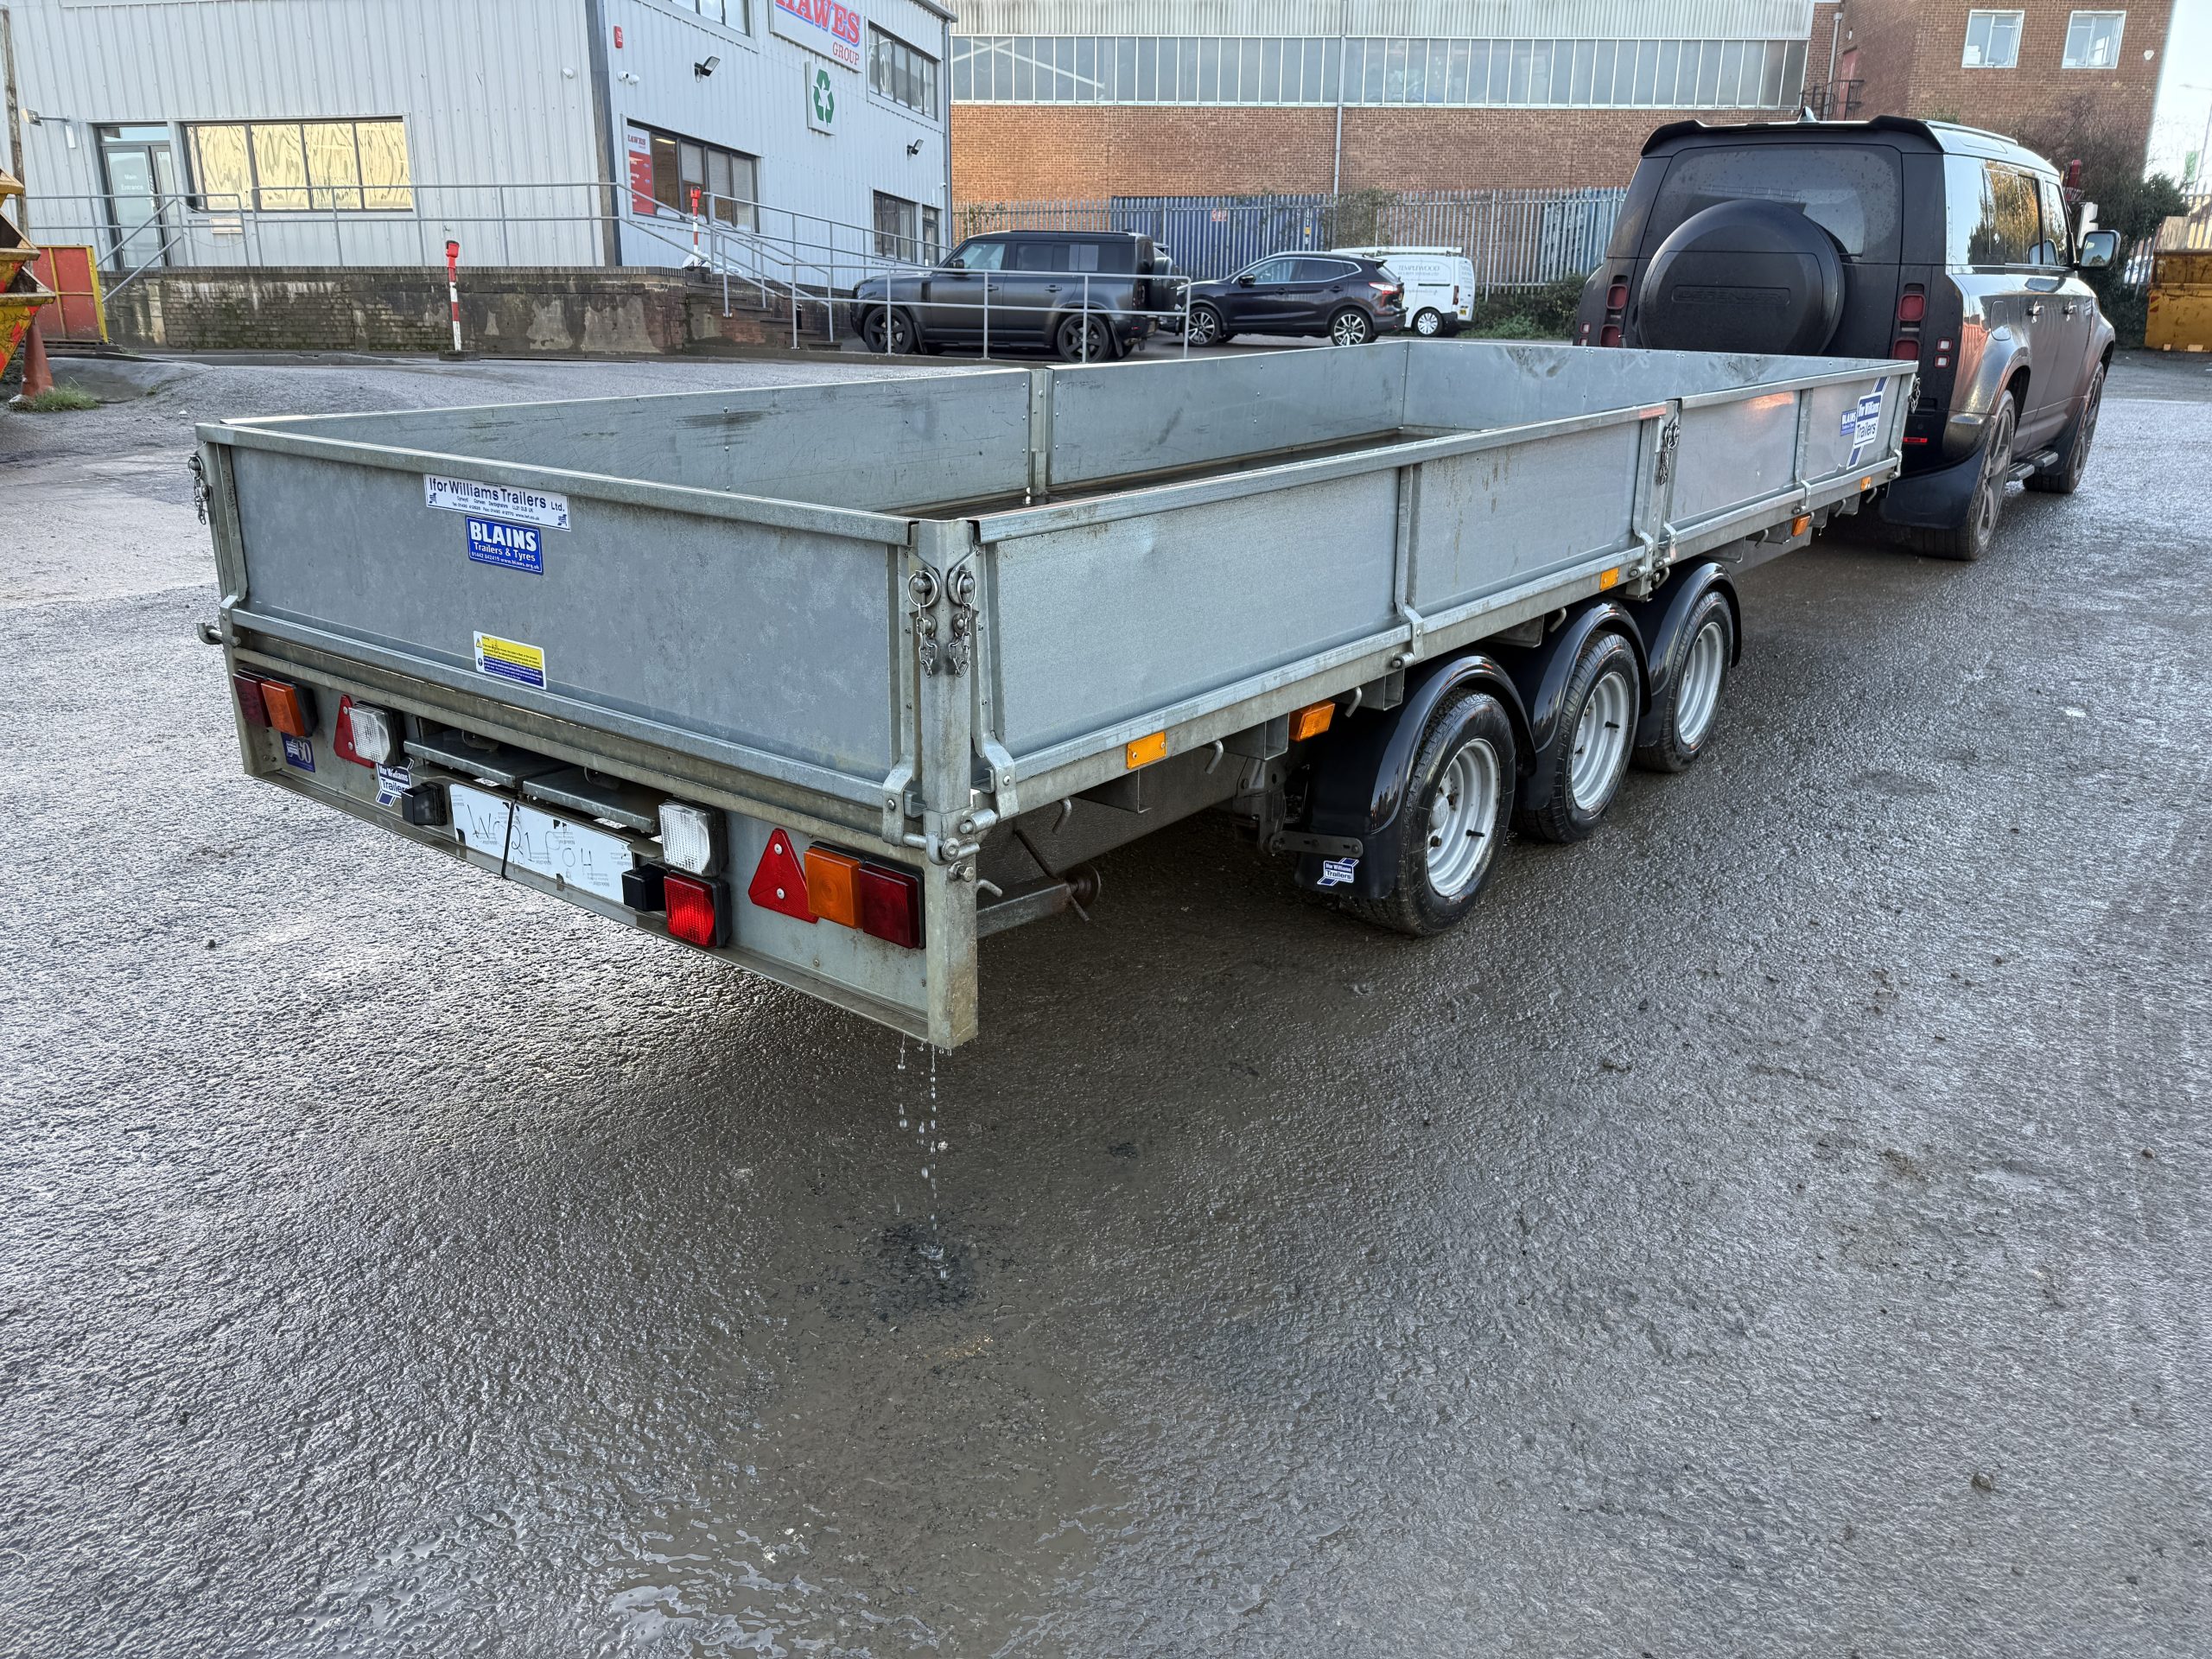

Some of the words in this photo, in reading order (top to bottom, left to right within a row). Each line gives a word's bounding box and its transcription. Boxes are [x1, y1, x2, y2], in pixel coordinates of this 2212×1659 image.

[832, 41, 860, 66] GROUP
[1856, 422, 1877, 438] Trailers
[429, 477, 448, 493] Ifor
[448, 480, 499, 501] Williams
[499, 487, 547, 509] Trailers
[550, 501, 565, 512] Ltd.
[470, 521, 537, 552] BLAINS
[474, 541, 503, 556] Trailers
[505, 547, 512, 557] &
[513, 549, 536, 562] Tyres
[381, 778, 405, 792] Trailer
[1325, 869, 1351, 879] Trailers
